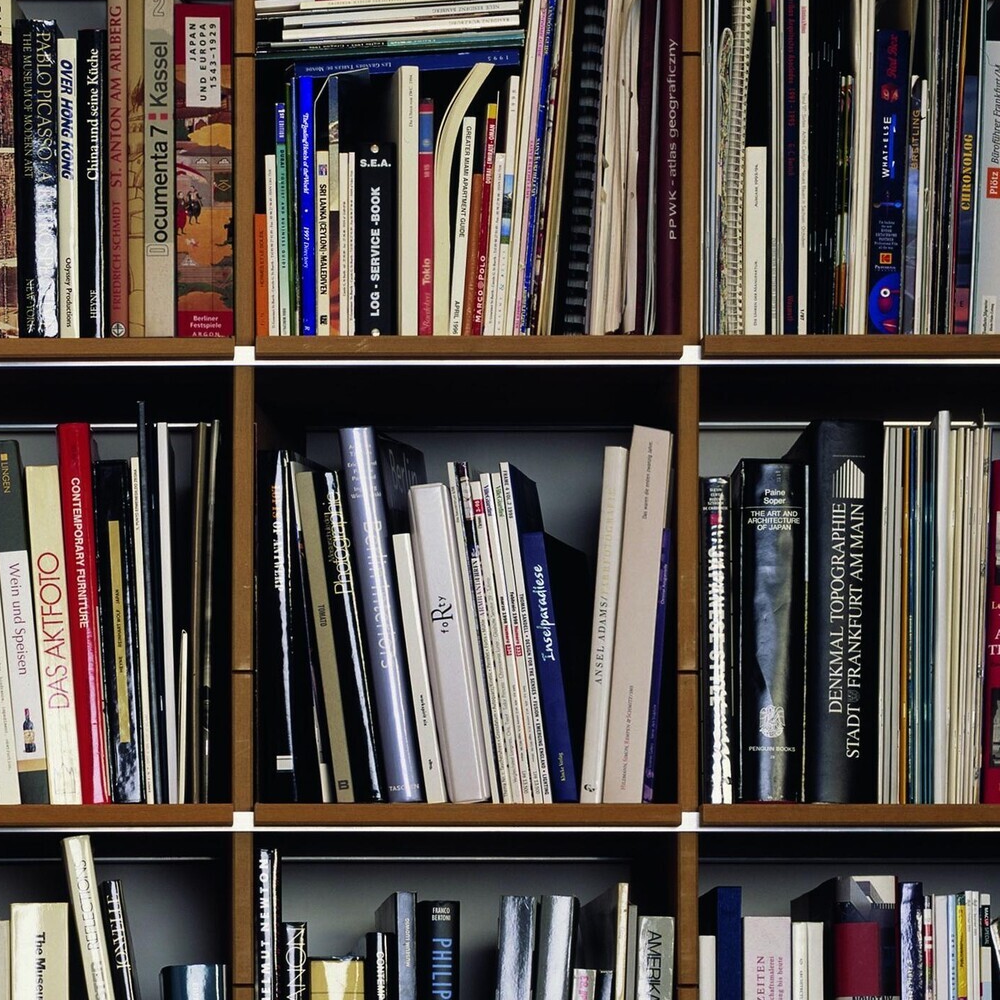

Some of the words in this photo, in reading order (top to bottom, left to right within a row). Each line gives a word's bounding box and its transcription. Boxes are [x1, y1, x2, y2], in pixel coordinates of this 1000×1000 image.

[666, 38, 679, 138] geograficzny
[668, 142, 676, 178] atlas
[961, 134, 973, 210] CHRONOLOG
[371, 228, 380, 282] SERVICE
[478, 256, 486, 282] POLO
[371, 291, 380, 317] LOG
[474, 290, 484, 322] MARCO
[72, 478, 84, 567] CONTEMPORARY
[764, 497, 786, 505] Soper
[850, 504, 864, 549] MAIN
[9, 562, 22, 597] Wein
[830, 503, 846, 622] TOPOGRAPHIE
[849, 554, 862, 581] AM
[12, 600, 26, 624] und
[38, 552, 66, 660] AKTFOTO
[76, 568, 90, 628] FURNITURE
[532, 564, 556, 662] Inselparadiese
[14, 628, 27, 676] Speisen
[846, 584, 862, 688] FRANKFURT
[46, 664, 70, 710] DAS
[828, 626, 844, 713] DENKMAL
[845, 704, 860, 758] STADT
[259, 859, 270, 936] NEWTON
